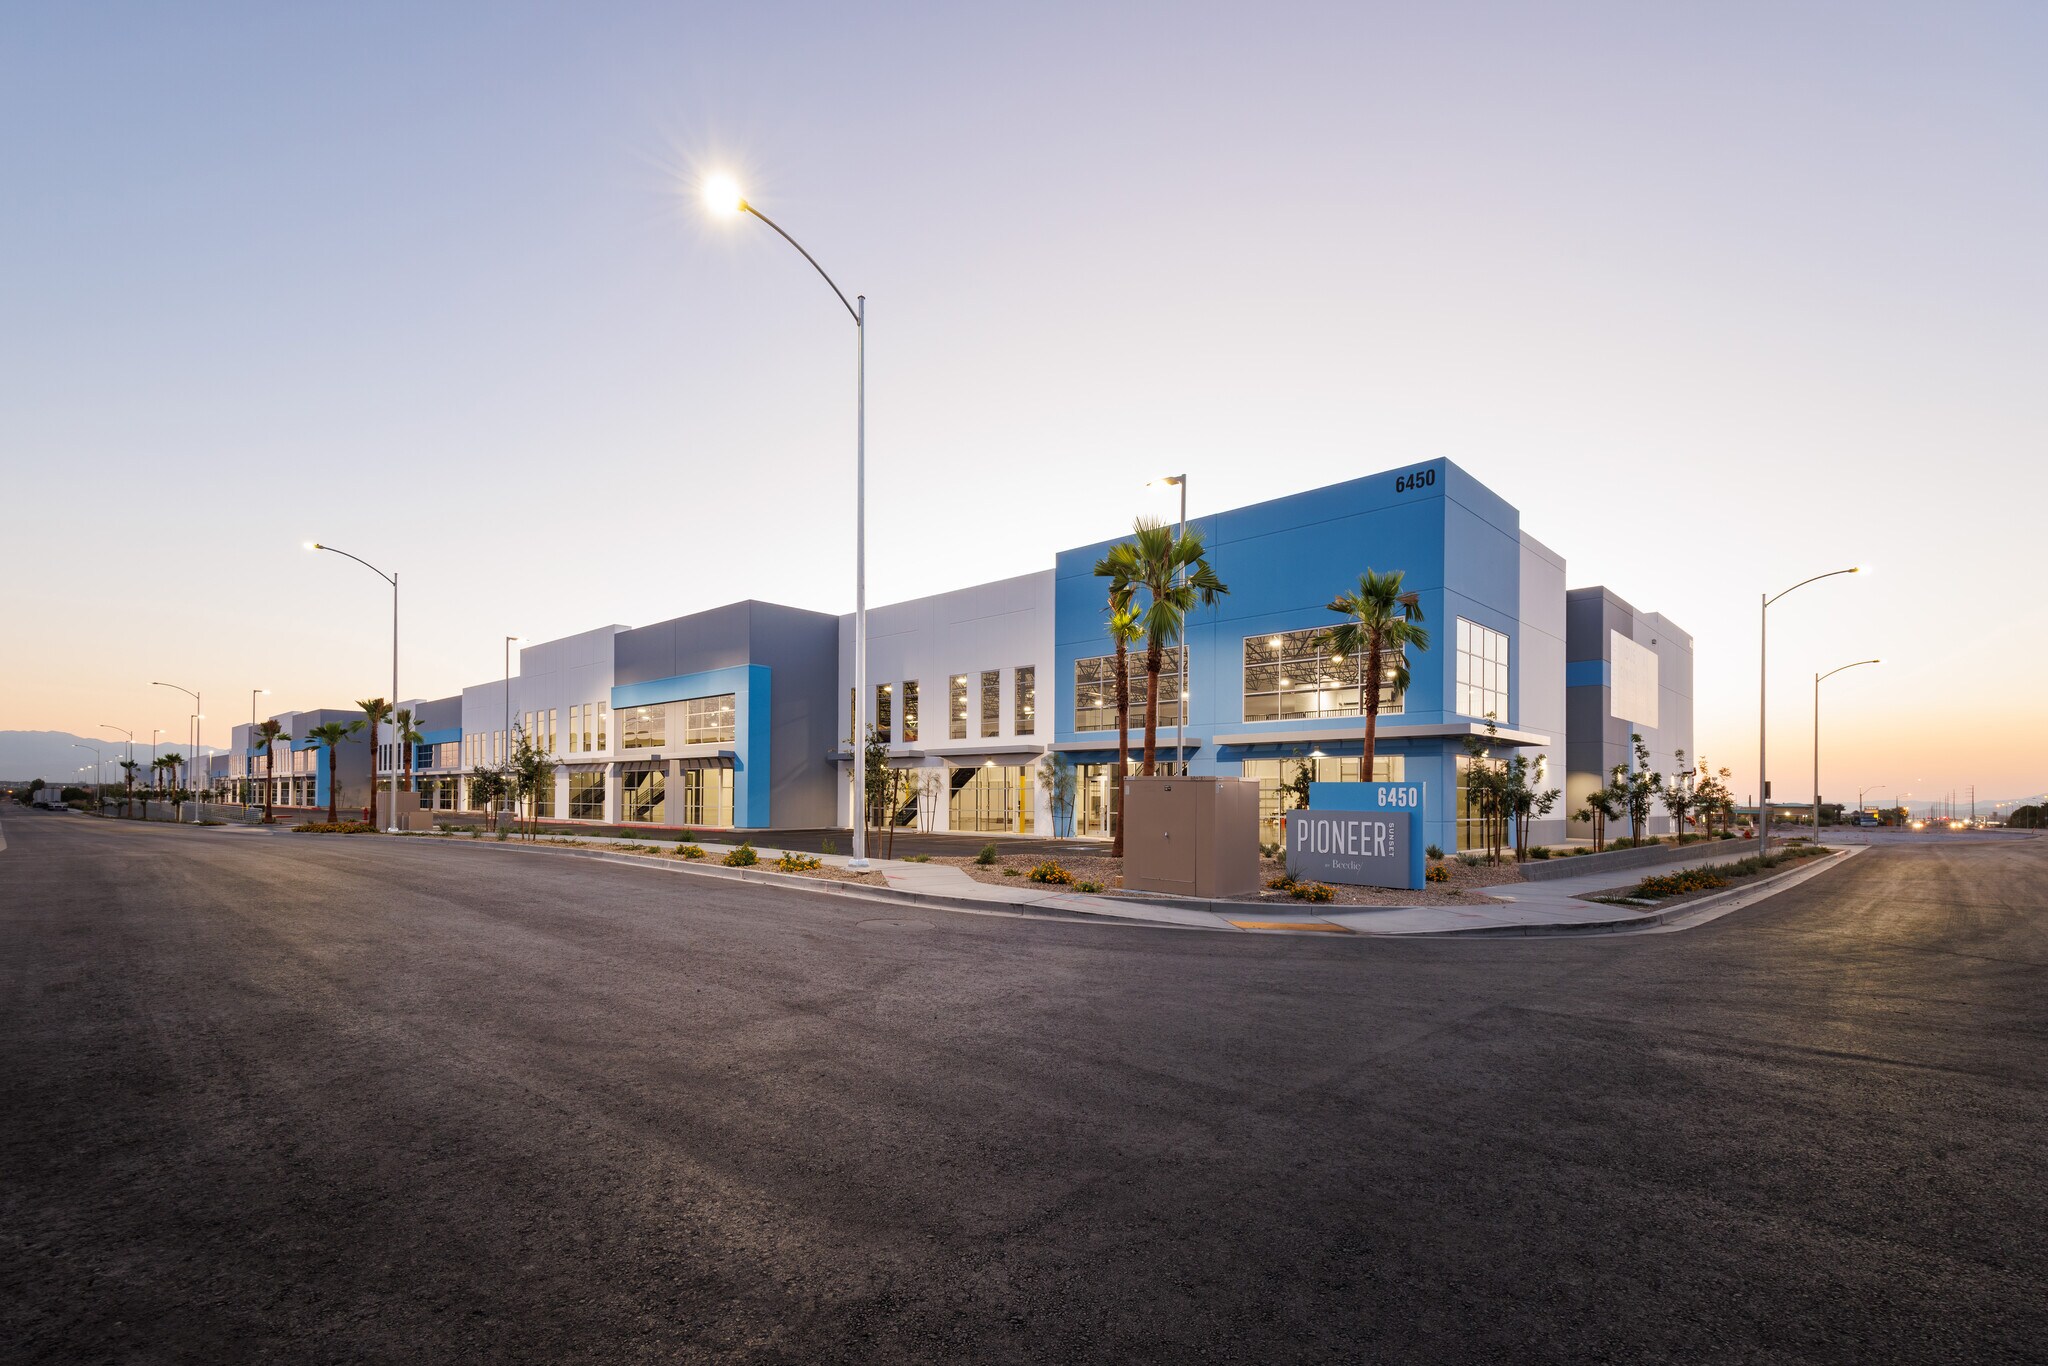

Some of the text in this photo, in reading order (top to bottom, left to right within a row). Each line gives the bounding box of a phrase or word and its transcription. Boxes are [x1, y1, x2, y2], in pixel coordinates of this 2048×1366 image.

[1396, 469, 1435, 493] 6450
[1378, 787, 1417, 807] 6450
[1297, 819, 1387, 857] PIONEER
